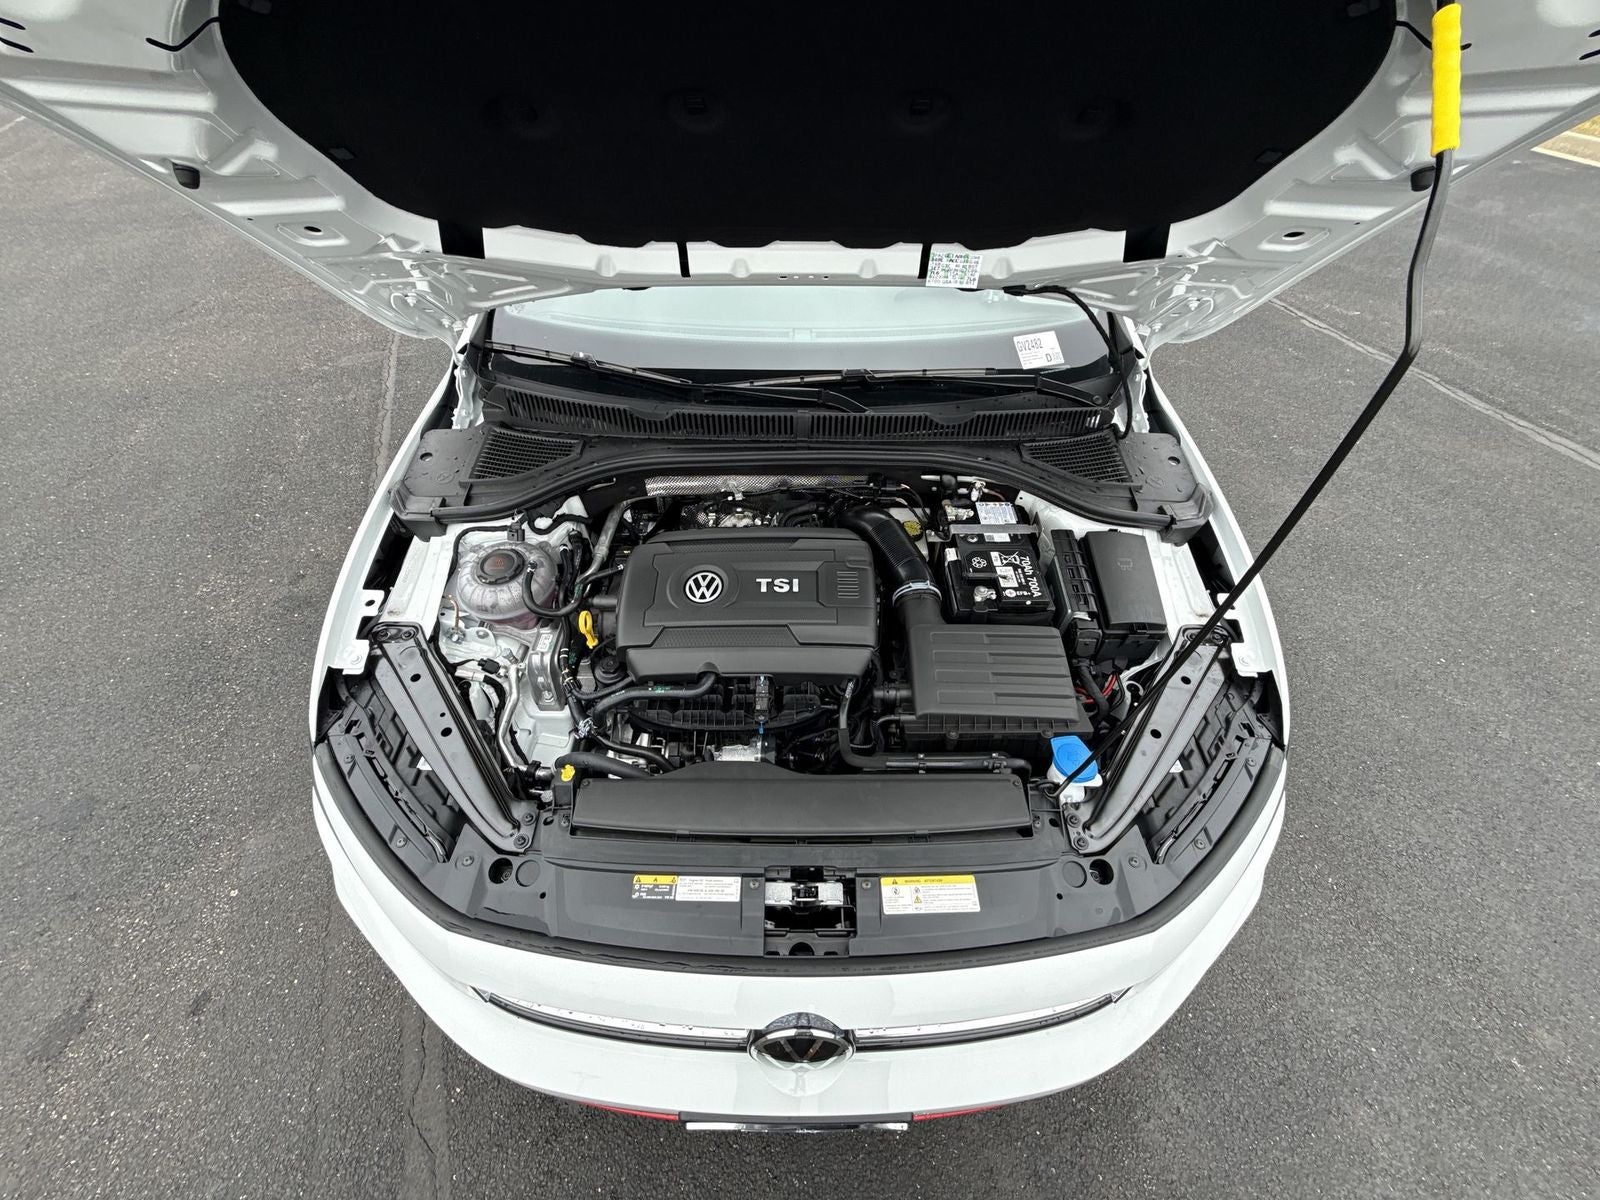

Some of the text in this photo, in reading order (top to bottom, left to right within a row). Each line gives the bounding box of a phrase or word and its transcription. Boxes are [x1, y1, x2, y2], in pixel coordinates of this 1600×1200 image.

[755, 578, 799, 593] TSI
[1020, 556, 1034, 576] 70Ah
[1027, 577, 1042, 598] 700A
